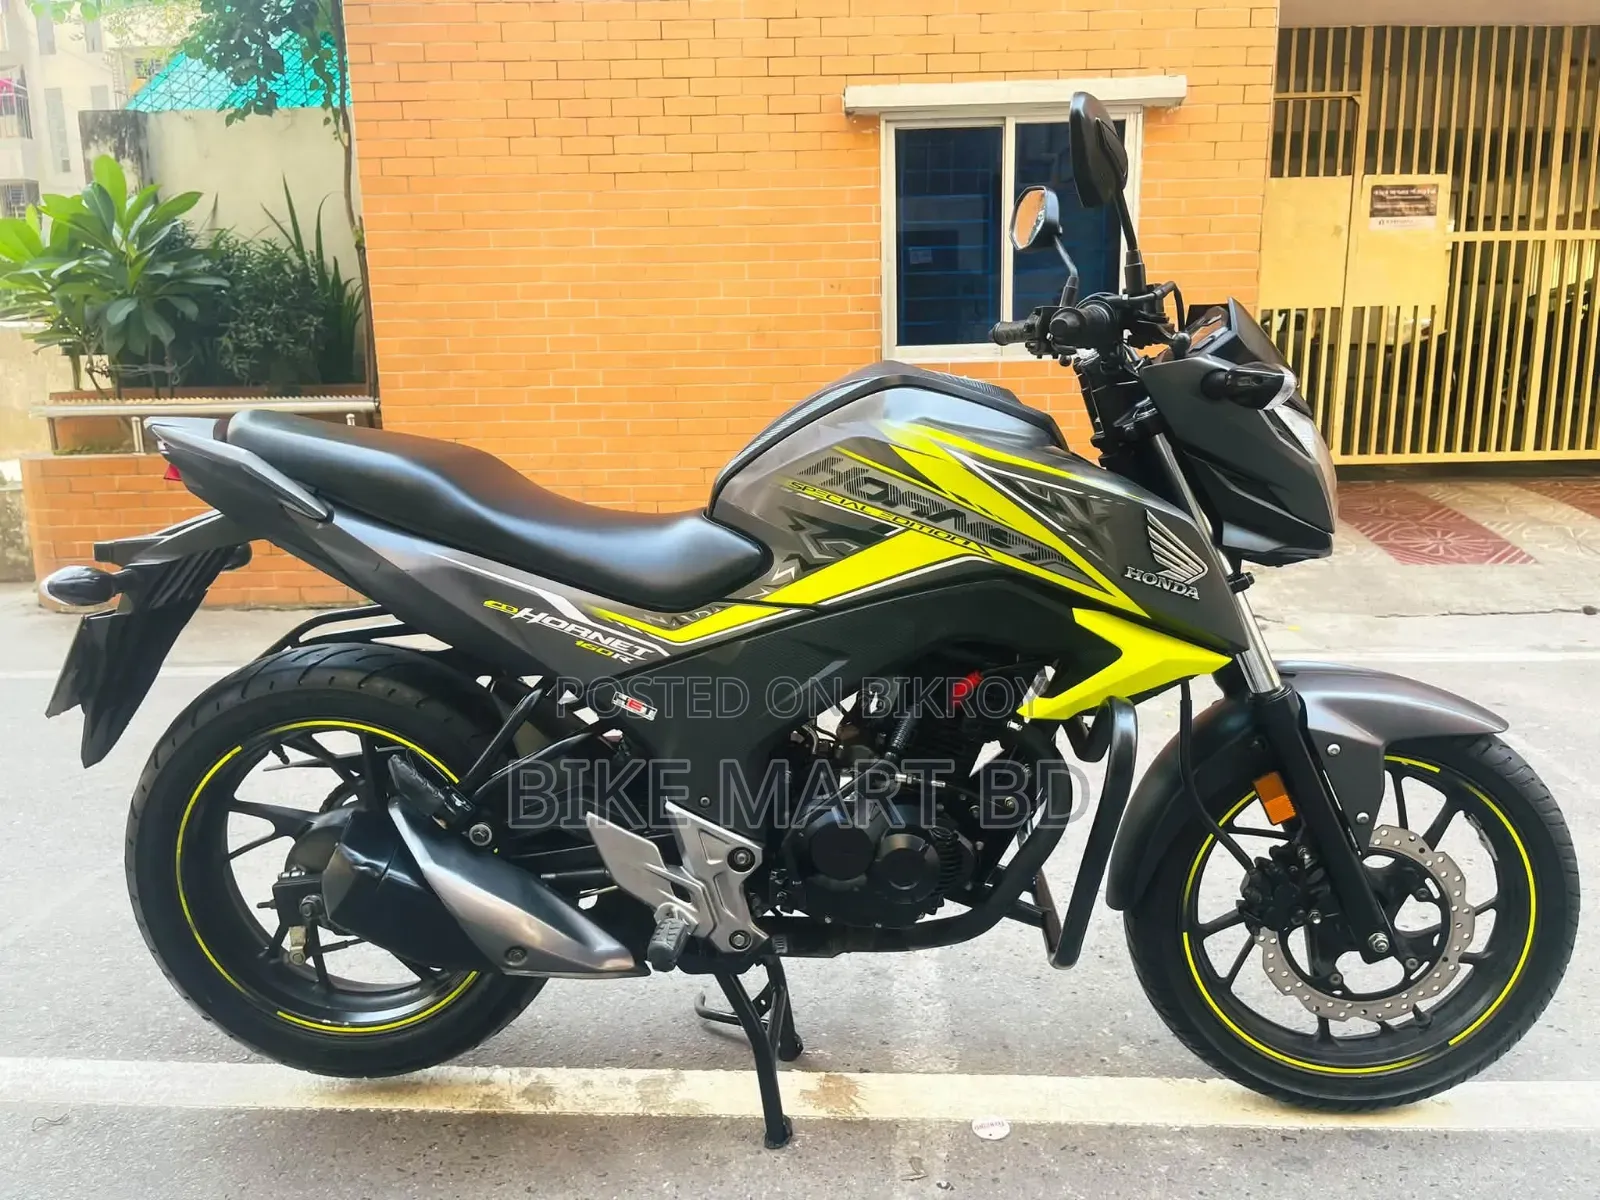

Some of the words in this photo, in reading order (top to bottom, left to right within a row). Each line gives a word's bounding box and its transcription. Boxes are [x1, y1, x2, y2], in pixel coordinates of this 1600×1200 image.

[788, 480, 872, 512] SPECIAL
[879, 511, 974, 546] EDITION
[1124, 566, 1200, 600] HONDA
[511, 607, 656, 661] HORNET
[574, 639, 635, 665] 160R
